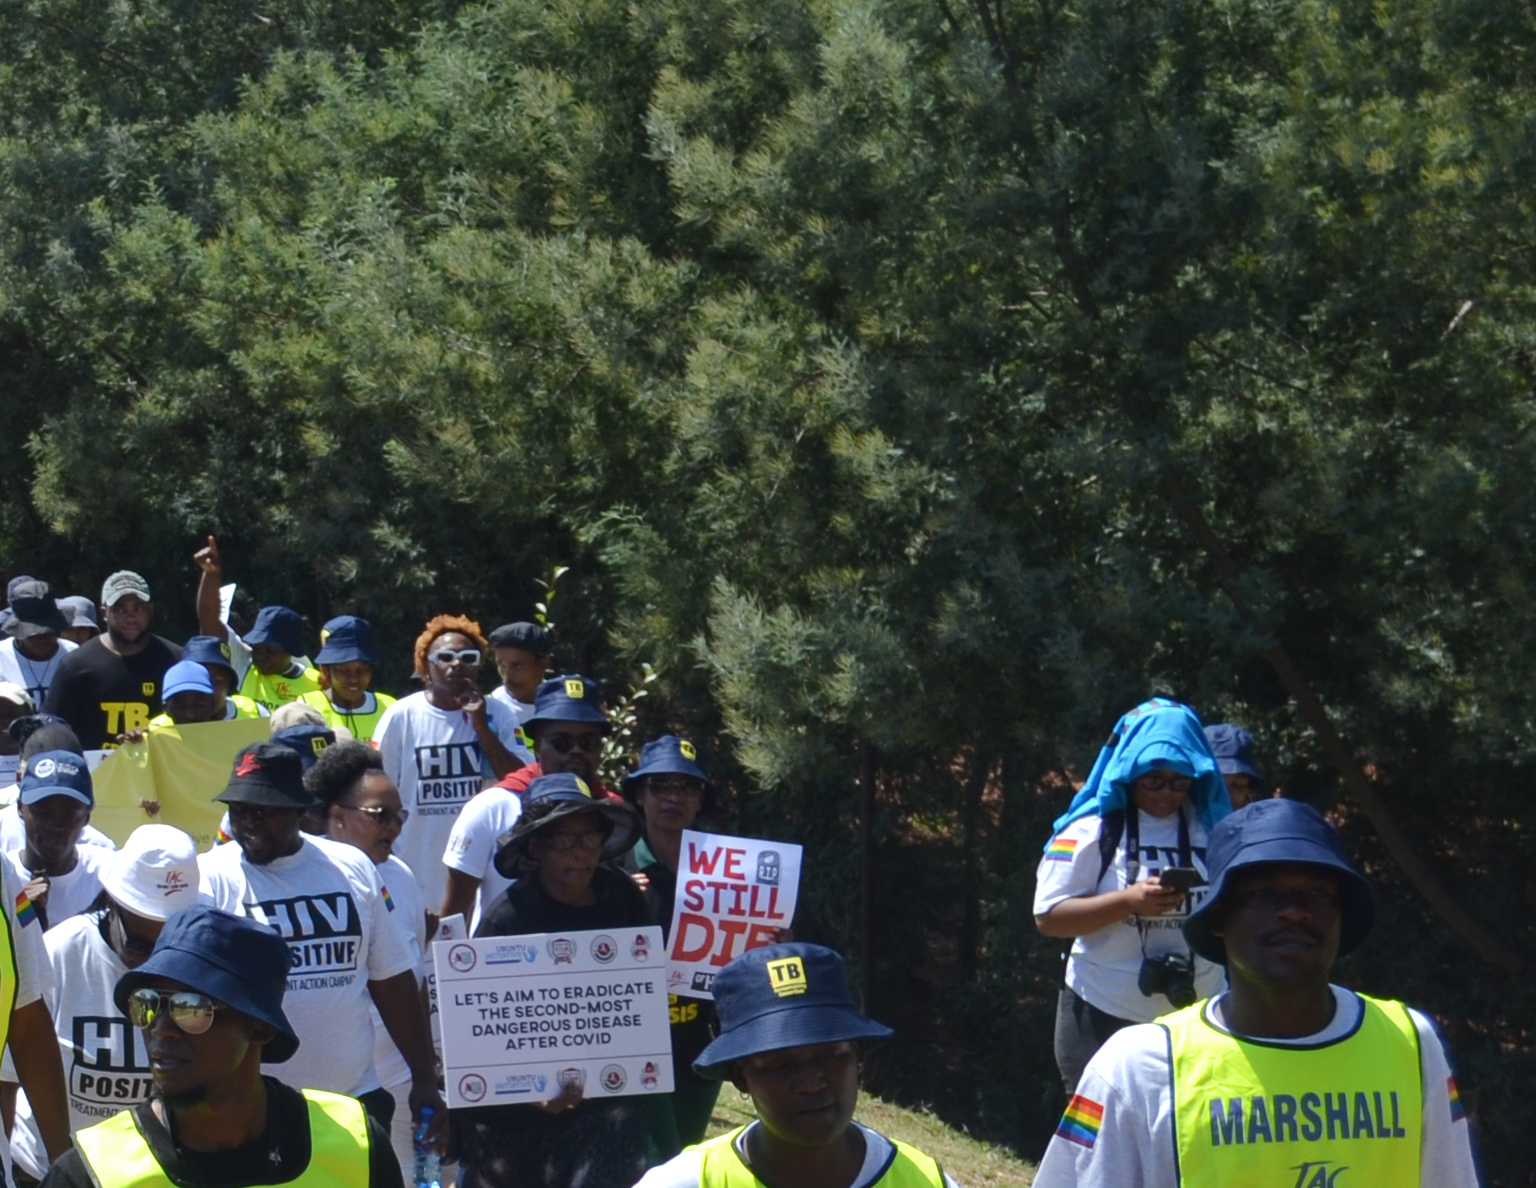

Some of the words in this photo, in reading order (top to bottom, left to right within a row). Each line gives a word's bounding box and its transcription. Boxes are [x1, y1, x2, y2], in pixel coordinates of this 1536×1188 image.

[100, 701, 150, 735] TB
[314, 739, 326, 750] TB
[689, 842, 746, 880] WE
[683, 879, 784, 920] STILL
[292, 939, 355, 968] SITIVE
[299, 977, 328, 991] ACTION
[771, 963, 800, 982] TB
[455, 990, 499, 1006] LET'S
[503, 989, 535, 1003] AIM
[538, 987, 560, 1000] TO
[564, 982, 654, 999] ERADICATE
[478, 1008, 511, 1020] THE
[515, 999, 633, 1019] SECOND-MOST
[472, 1019, 571, 1037] DANGEROUS
[576, 1014, 642, 1030] DISEASE
[505, 1036, 558, 1051] AFTER
[562, 1032, 612, 1047] COVID
[1209, 1091, 1406, 1147] MARSHALL
